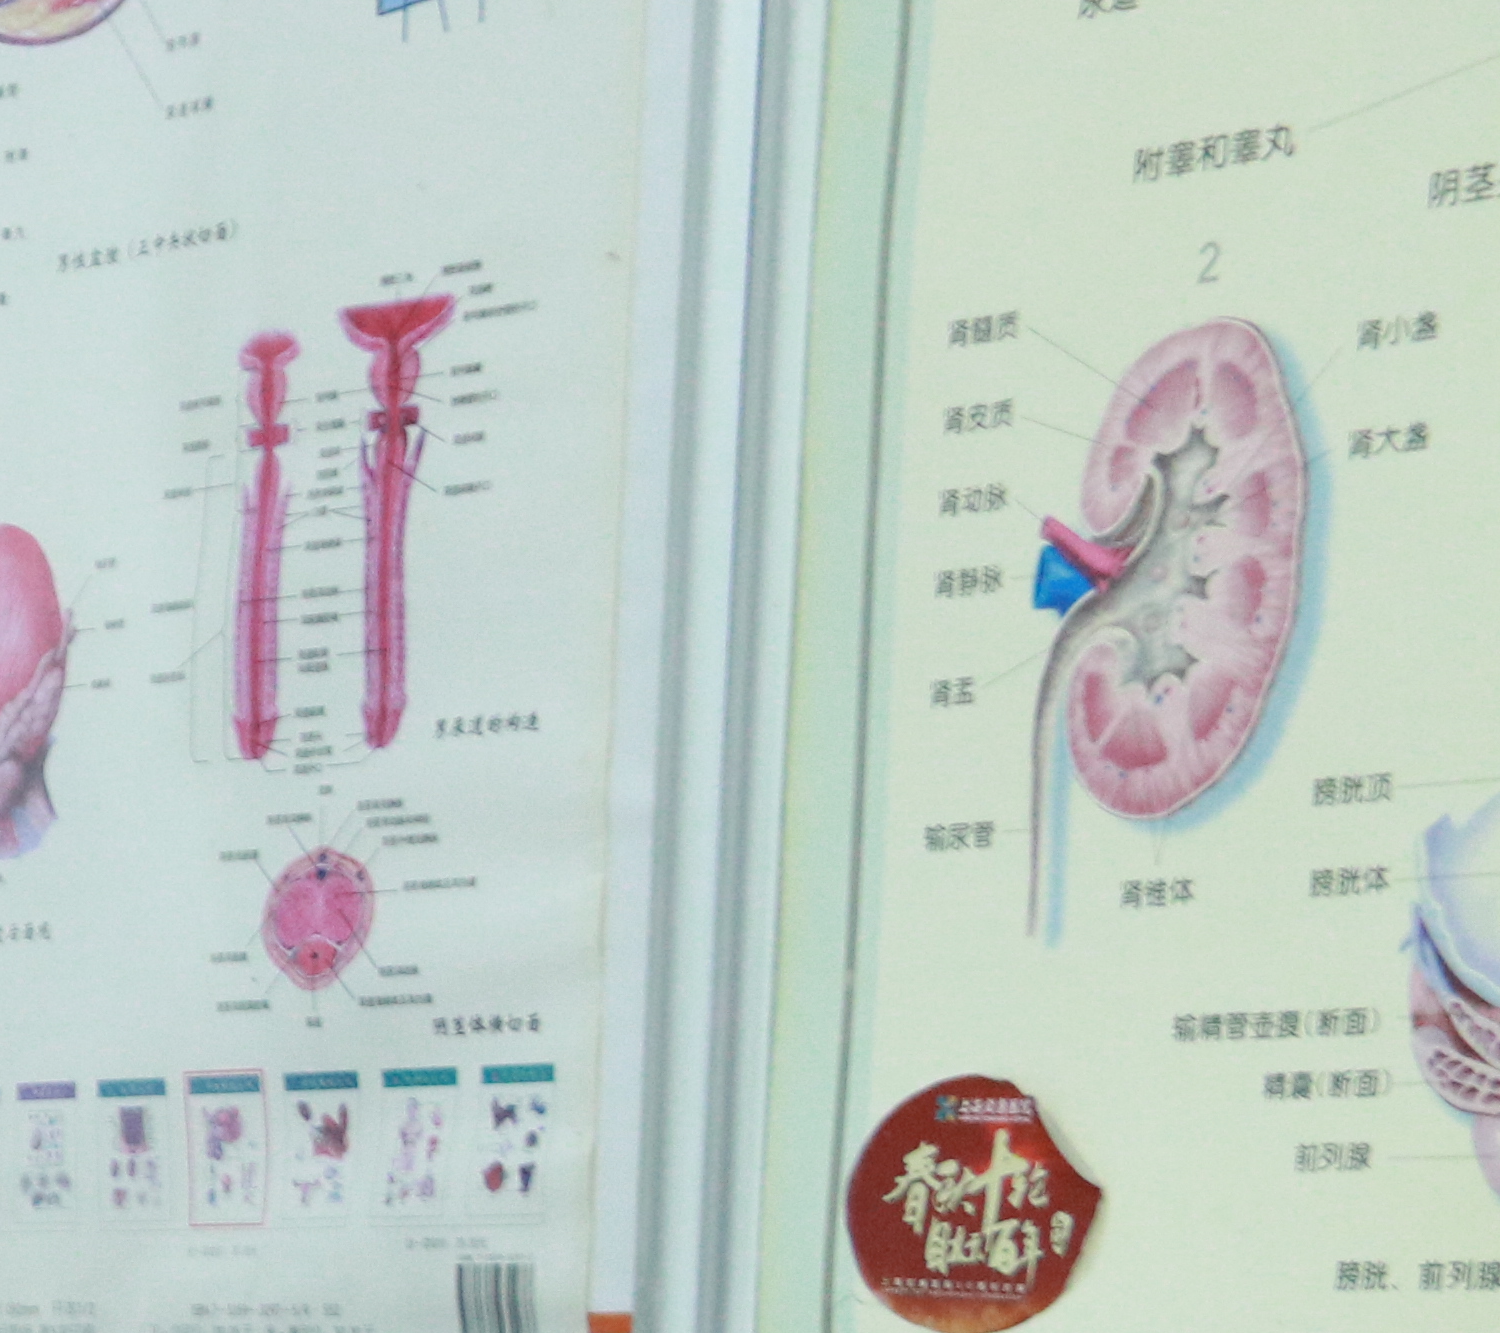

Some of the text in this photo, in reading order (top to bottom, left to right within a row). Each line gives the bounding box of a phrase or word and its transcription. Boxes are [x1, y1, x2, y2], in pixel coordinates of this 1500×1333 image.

[1132, 124, 1296, 183] 附睾和睾丸
[1198, 241, 1221, 285] 2
[943, 398, 1015, 435] 肾皮质
[1347, 422, 1429, 459] 肾大盏
[1311, 772, 1394, 806] 膀胱顶
[1309, 865, 1390, 897] 膀胱体
[1294, 1142, 1372, 1174] 前列腺
